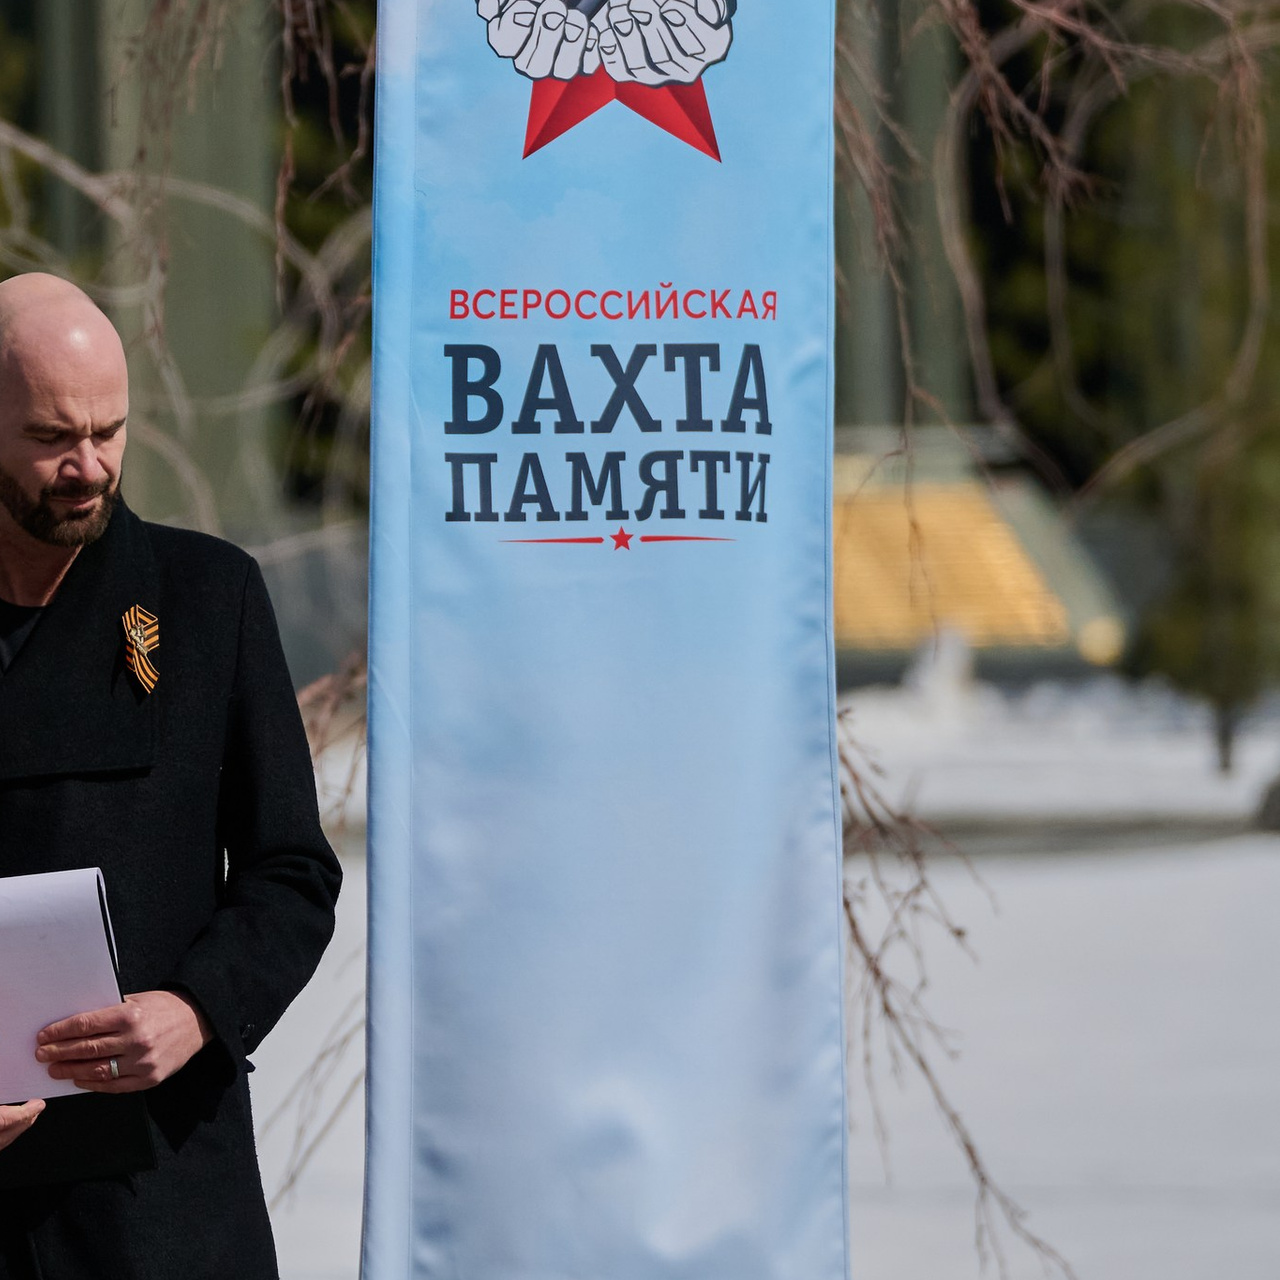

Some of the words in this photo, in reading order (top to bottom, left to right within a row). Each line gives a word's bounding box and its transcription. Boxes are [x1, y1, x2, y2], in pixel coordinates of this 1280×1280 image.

[448, 282, 778, 321] ВСЕРОССИЙСКАЯ
[443, 343, 773, 436] ВАХТА
[443, 449, 771, 523] ПАМЯТИ
